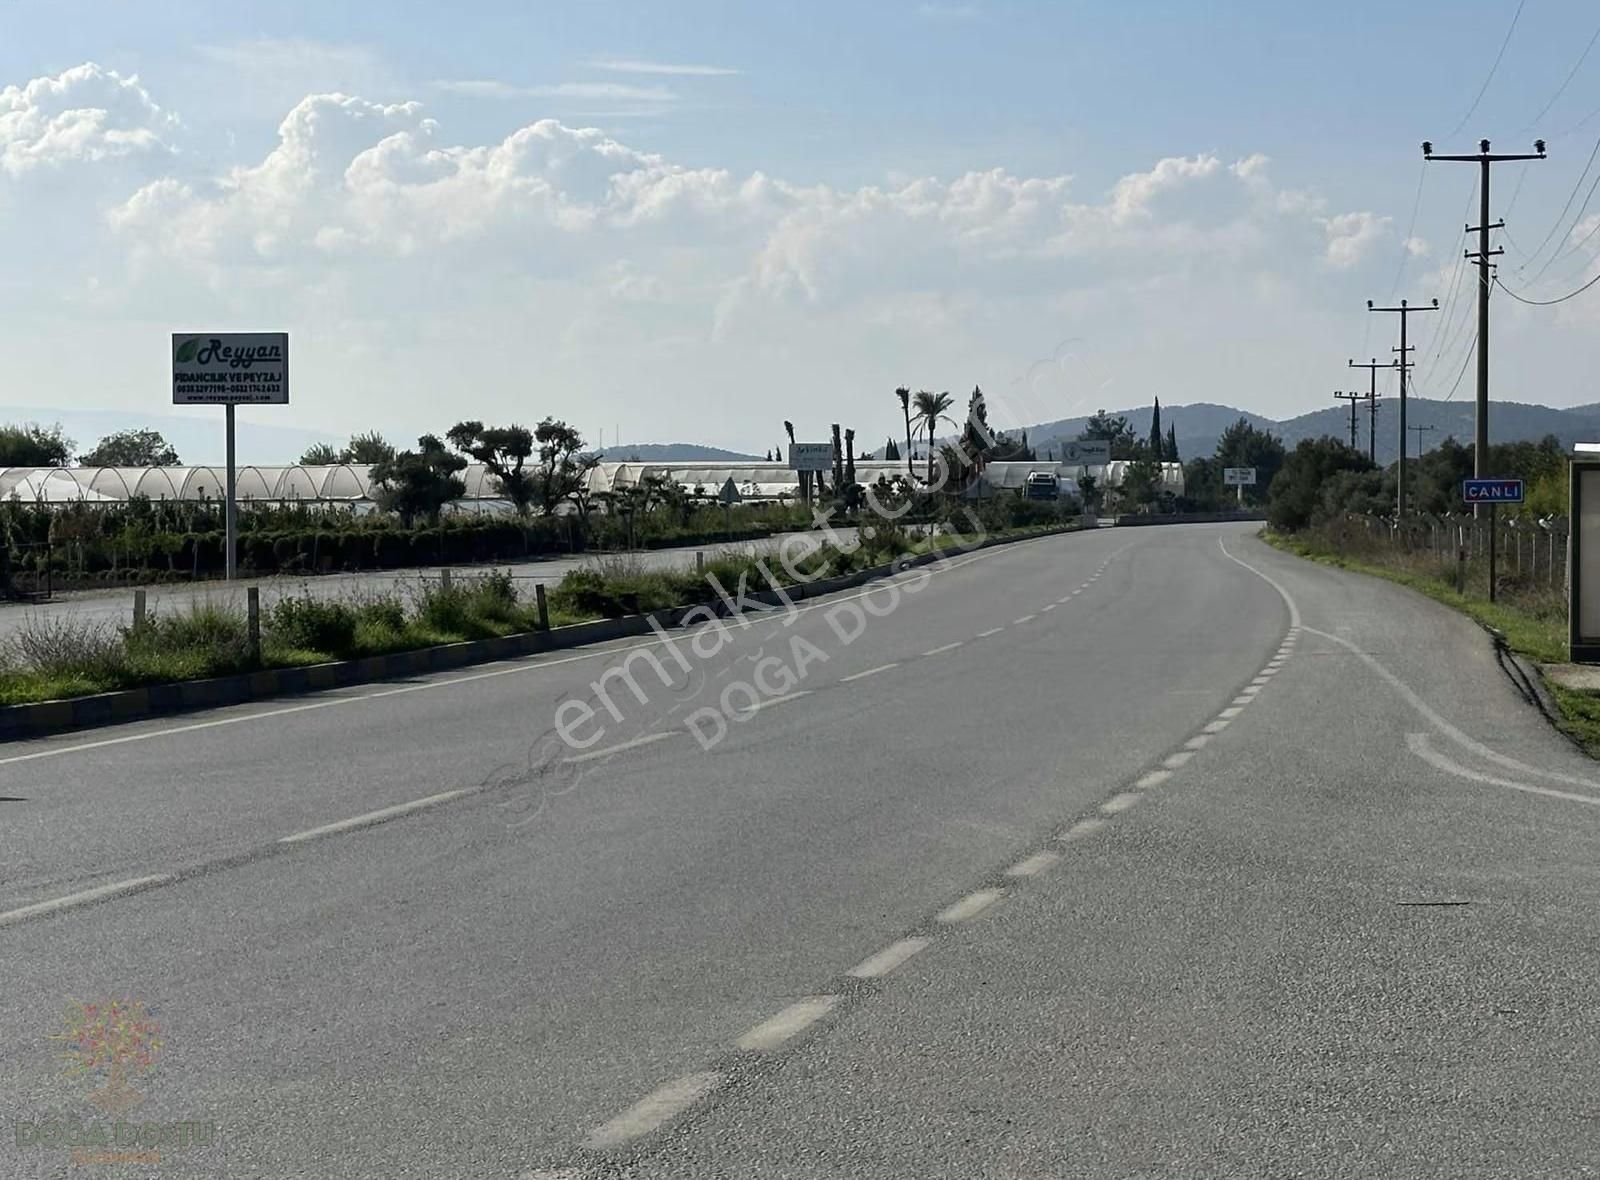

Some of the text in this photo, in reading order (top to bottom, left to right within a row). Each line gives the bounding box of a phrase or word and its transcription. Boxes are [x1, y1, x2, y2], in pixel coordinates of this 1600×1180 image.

[197, 339, 282, 369] Reyyan
[228, 372, 242, 383] VE
[243, 372, 282, 383] PEYZAJ
[1469, 486, 1518, 497] CANLI
